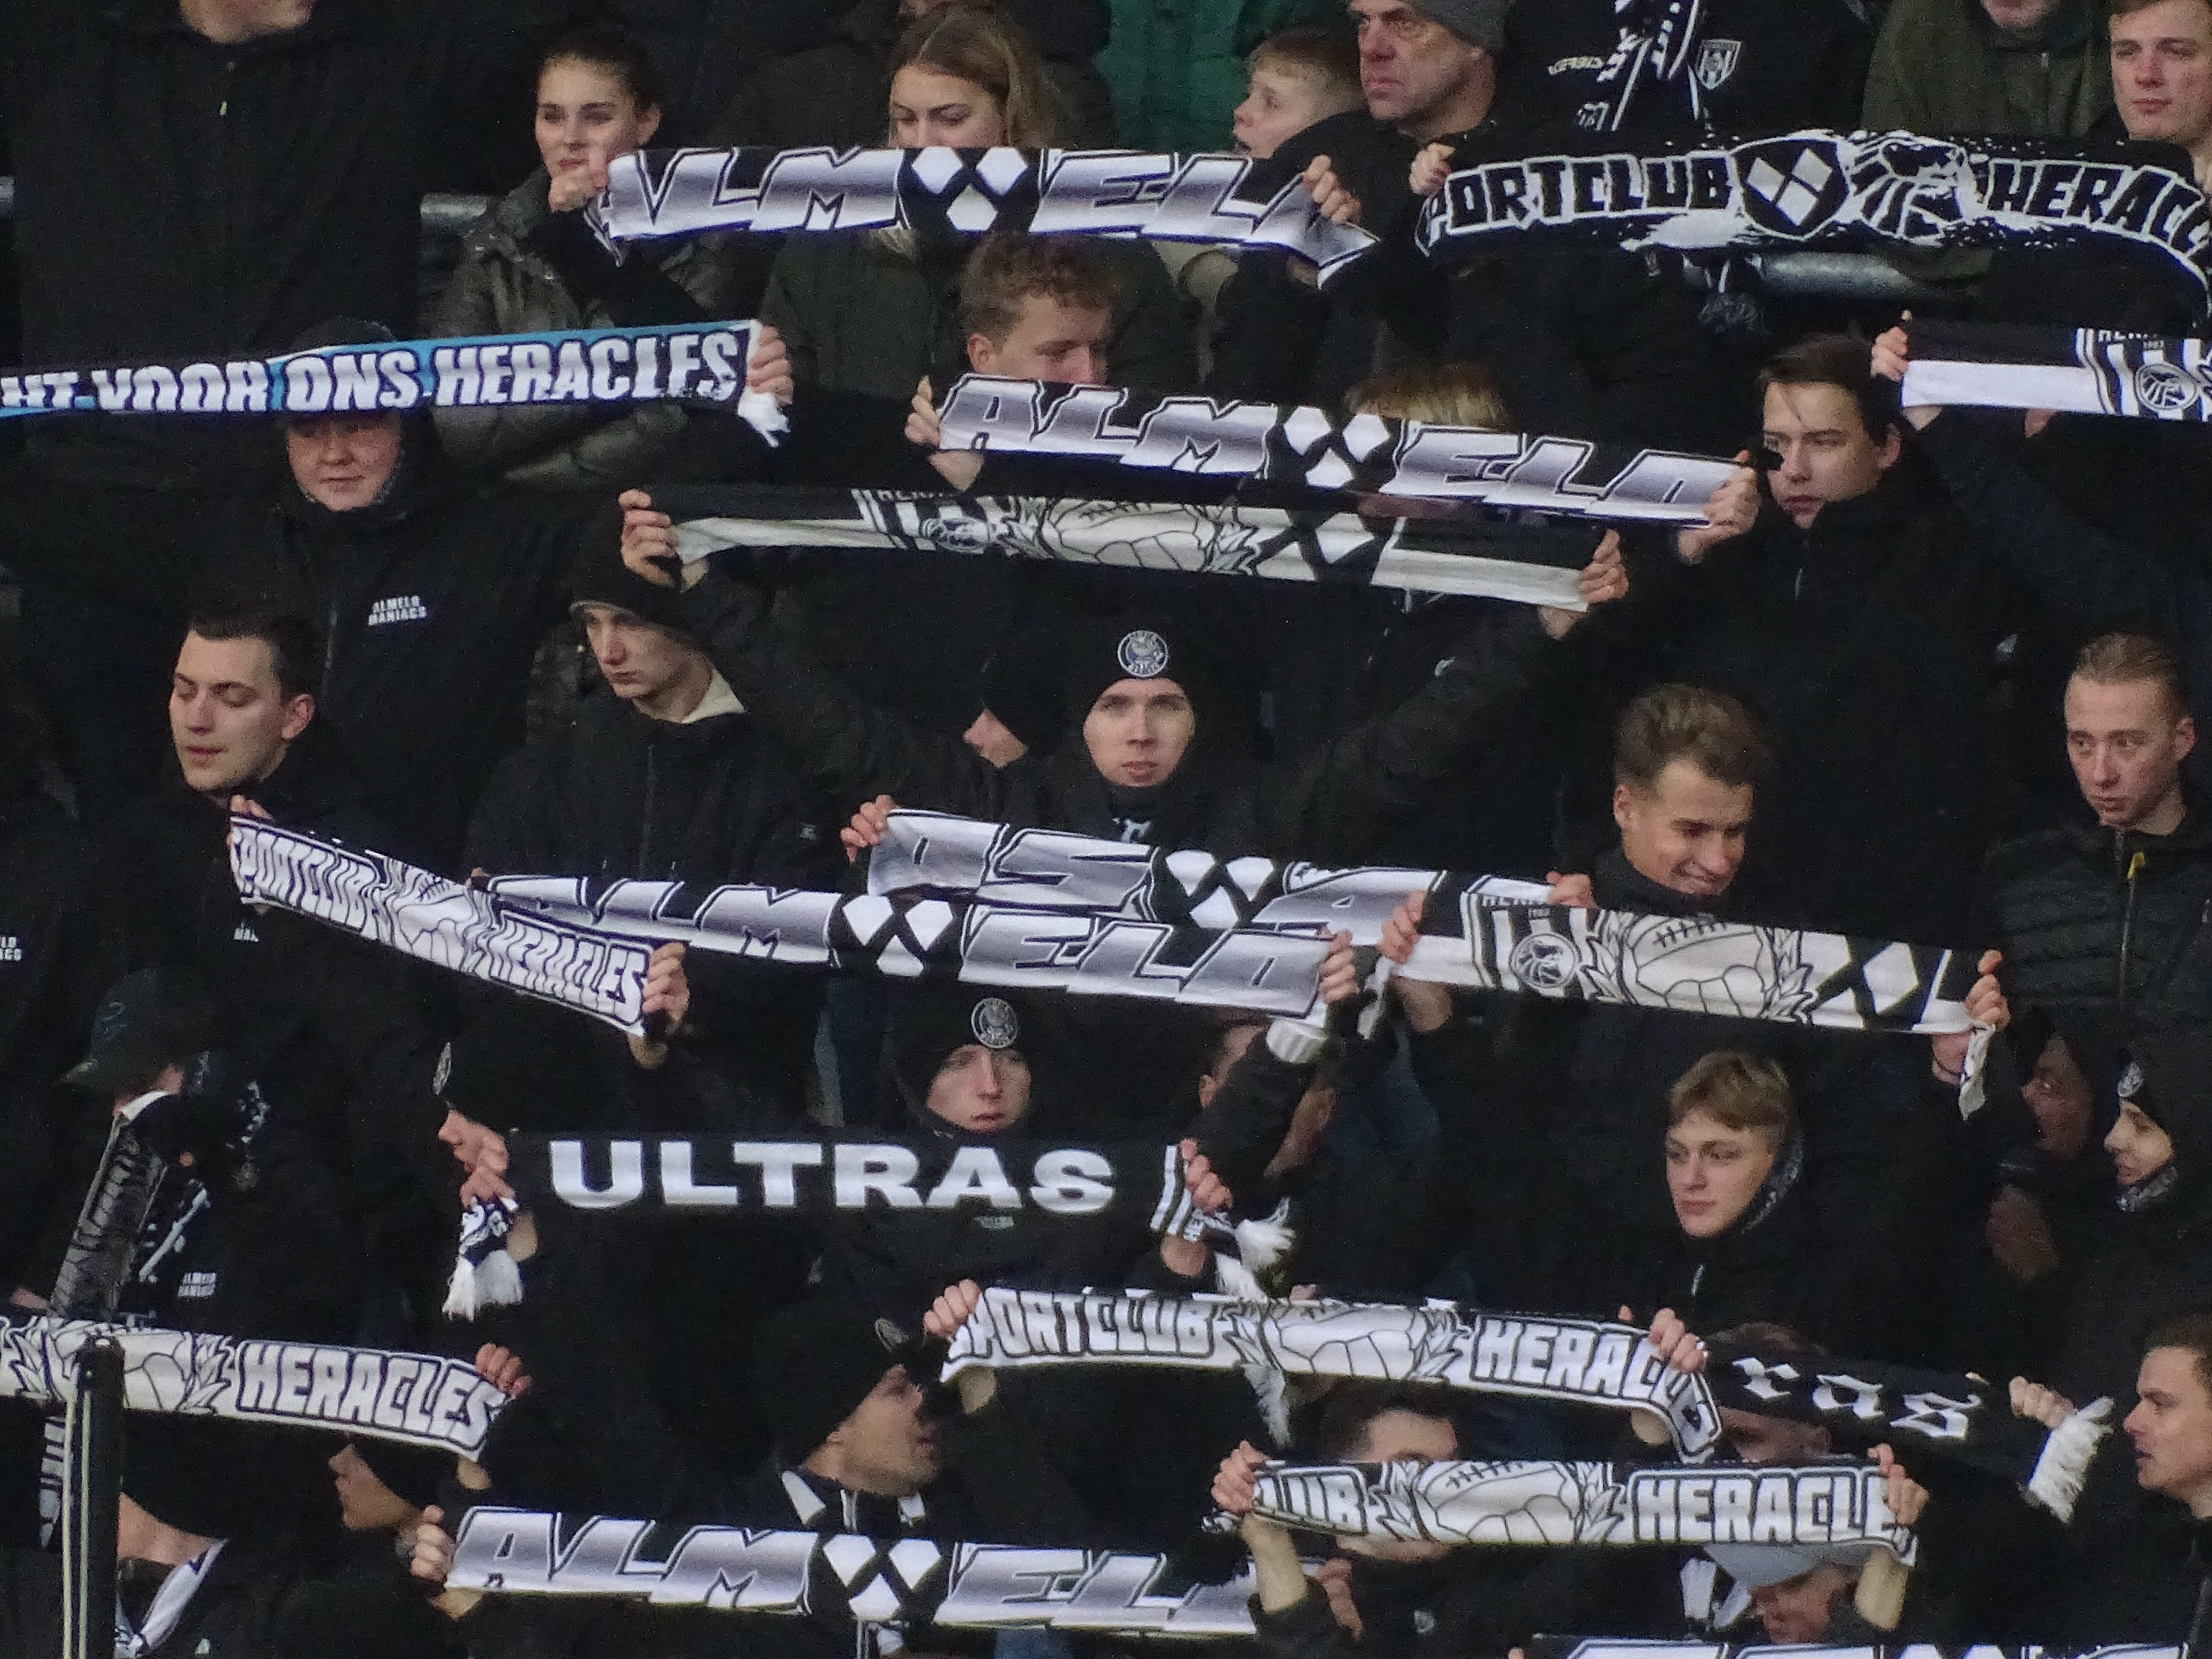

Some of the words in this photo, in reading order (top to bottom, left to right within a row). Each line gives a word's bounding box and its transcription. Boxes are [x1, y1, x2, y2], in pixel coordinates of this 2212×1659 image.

[286, 349, 419, 412] ONS
[434, 331, 740, 407] HERACLES
[368, 606, 427, 626] MANIACS
[548, 1139, 1114, 1214] ULTRAS
[236, 1339, 506, 1450] HERACLES
